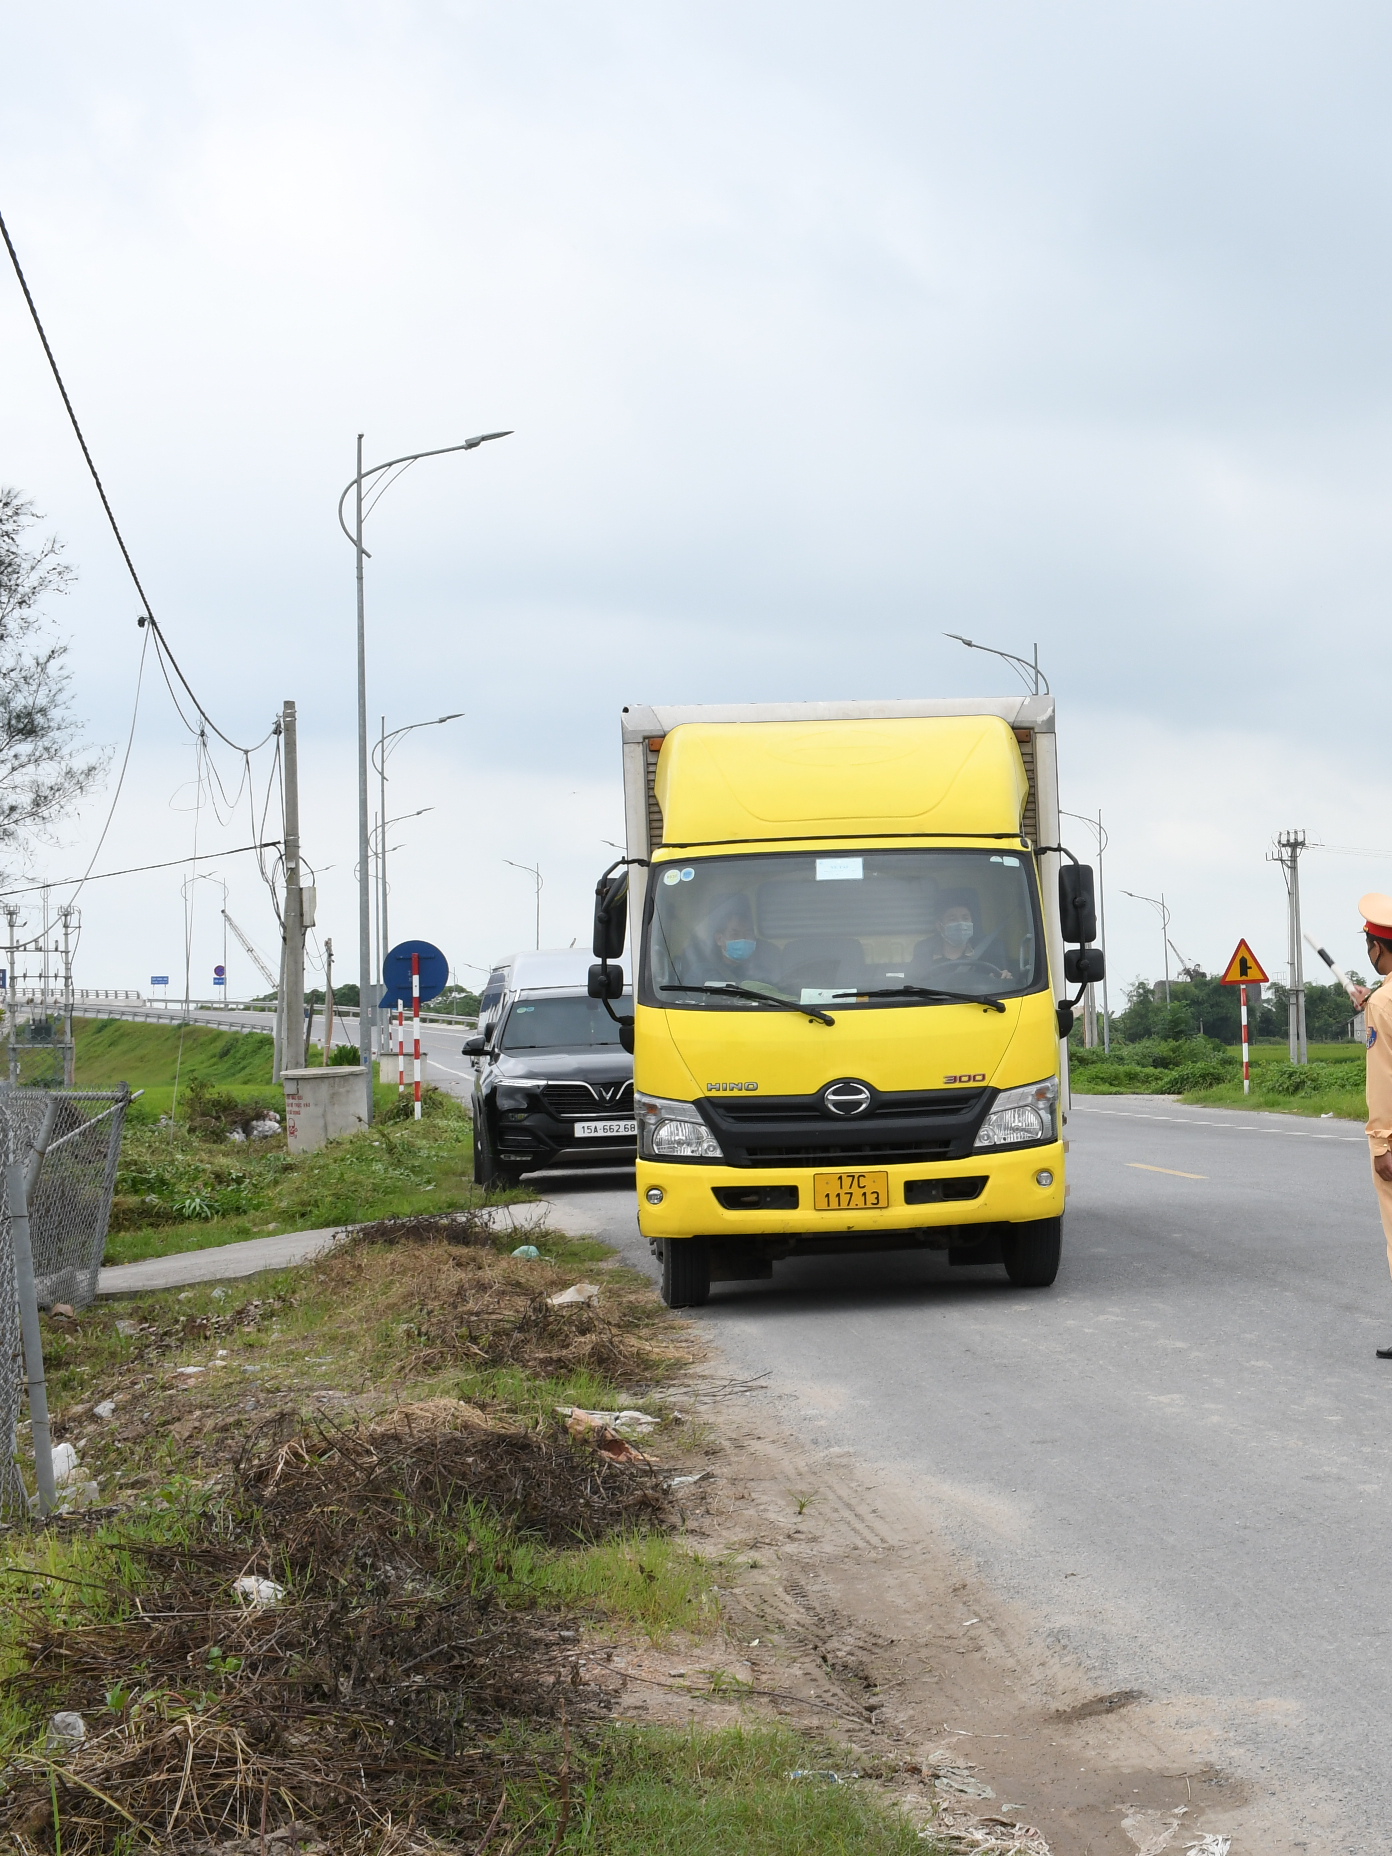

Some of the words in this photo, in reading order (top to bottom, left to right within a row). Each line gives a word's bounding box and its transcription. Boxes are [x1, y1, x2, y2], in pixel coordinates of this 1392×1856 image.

[943, 1073, 986, 1084] 300
[707, 1082, 758, 1091] HINO
[838, 1174, 866, 1189] 17C
[825, 1191, 880, 1207] 117.13
